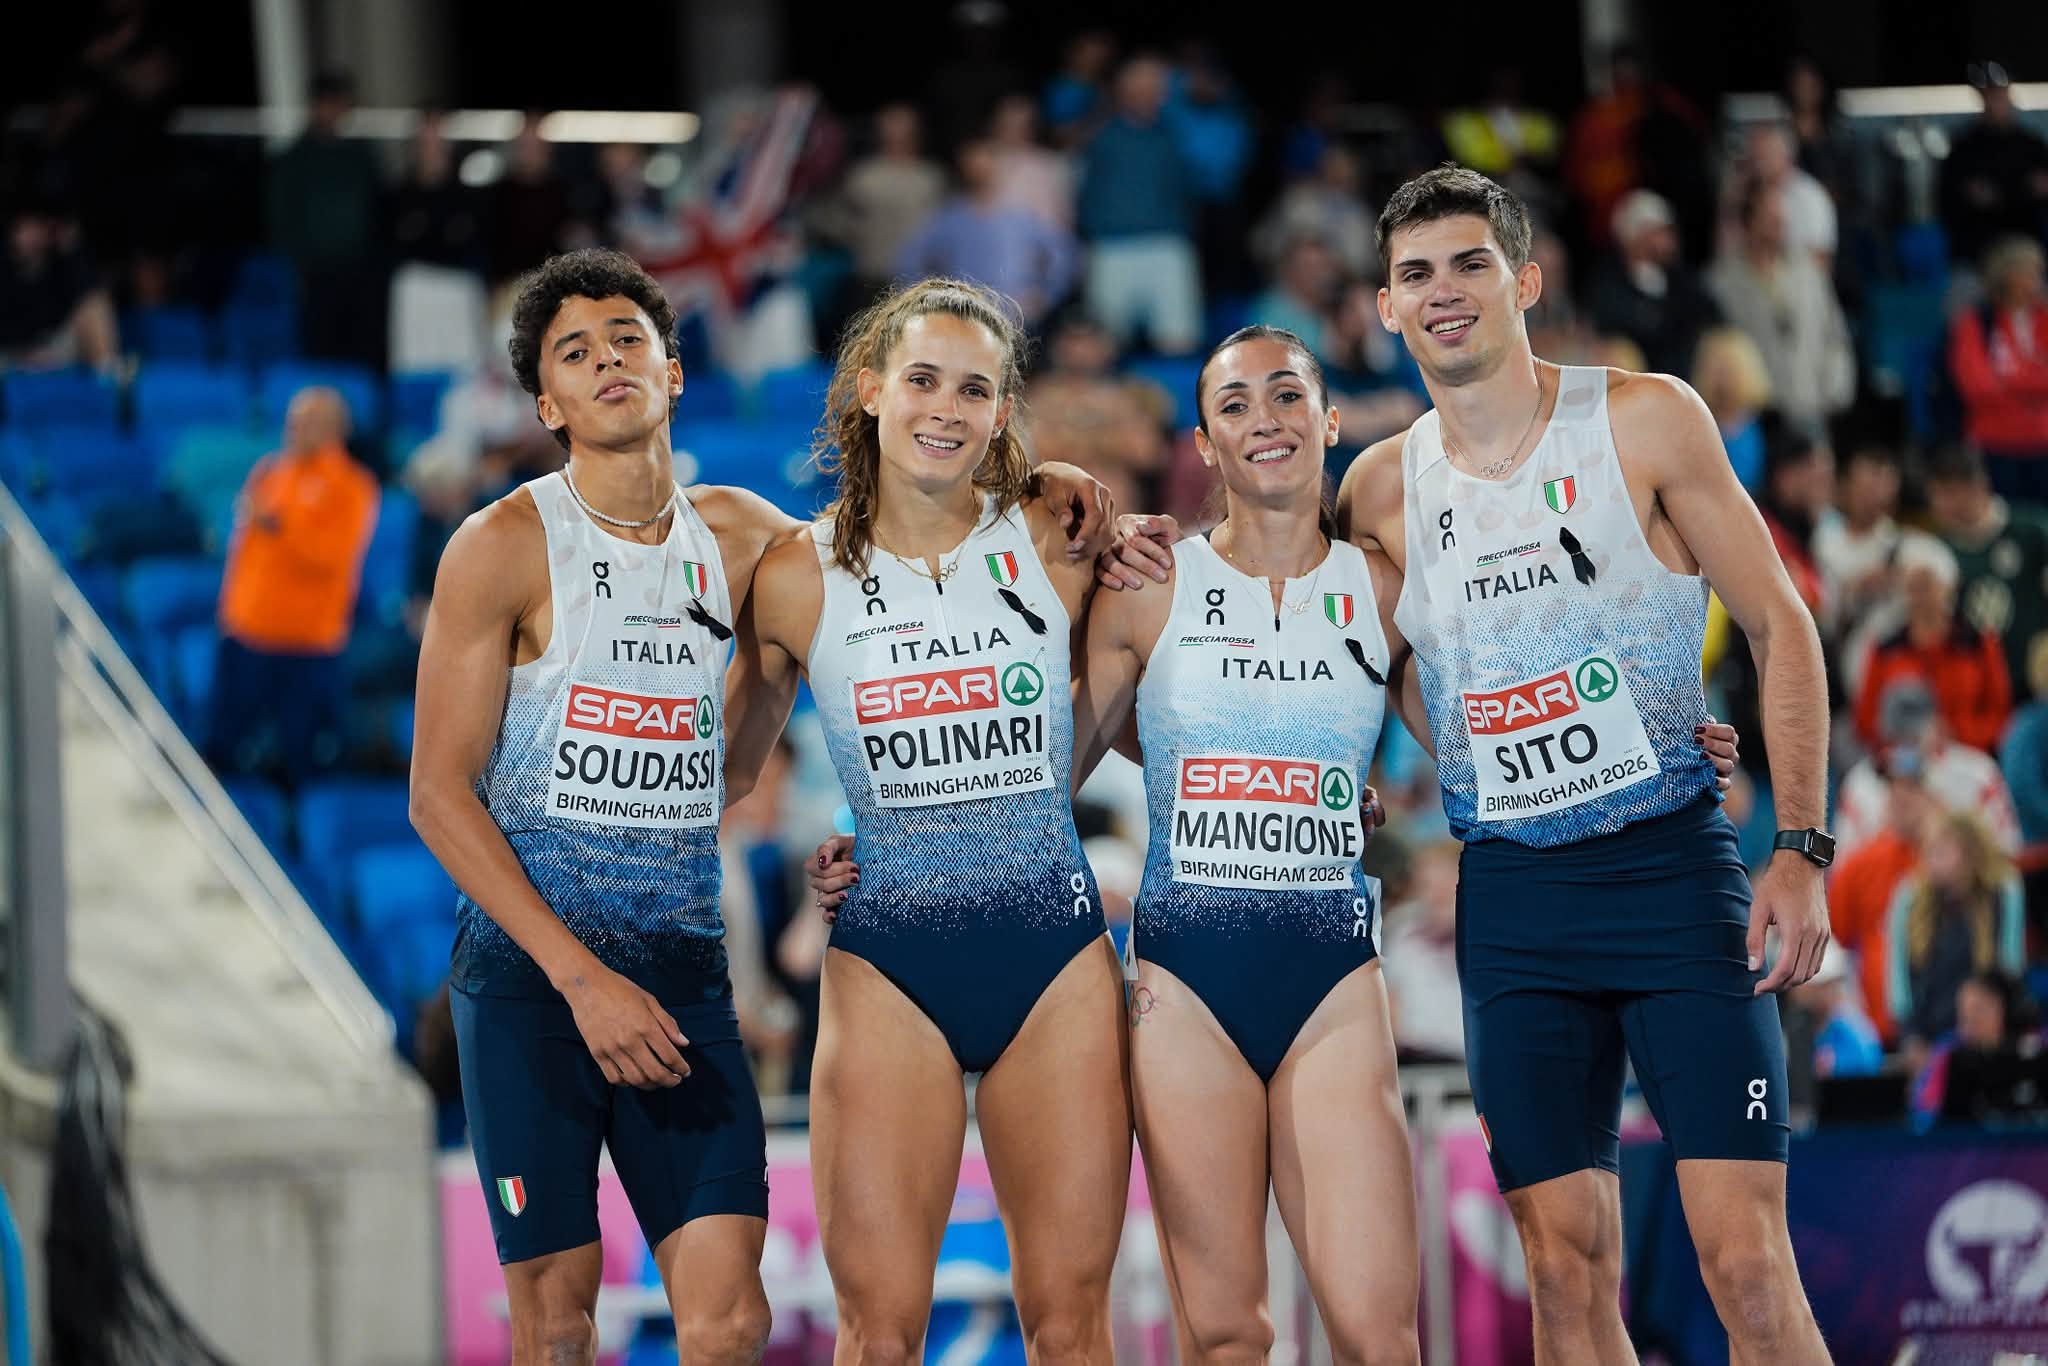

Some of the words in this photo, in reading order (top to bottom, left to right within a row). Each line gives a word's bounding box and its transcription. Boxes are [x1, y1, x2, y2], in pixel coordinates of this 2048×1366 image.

[1477, 541, 1541, 564] FRECCIAROSSA
[1464, 564, 1558, 602] ITALIA
[846, 621, 924, 641] FRECCIAROSSA
[891, 627, 1011, 663] ITALIA
[1179, 635, 1256, 645] FRECCIAROSSA
[612, 639, 695, 665] ITALIA
[1222, 657, 1334, 681] ITALIA
[571, 692, 694, 735] SPAR
[859, 673, 995, 718] SPAR
[1467, 680, 1573, 729] SPAR
[864, 714, 1043, 771] POLINARI
[1495, 723, 1598, 783] SITO
[555, 740, 715, 792] SOUDASSI
[880, 773, 999, 799] BIRMINGHAM
[1003, 766, 1044, 786] 2026
[1186, 764, 1315, 799] SPAR
[1486, 776, 1599, 813] BIRMINGHAM
[1600, 754, 1648, 785] 2026
[556, 792, 682, 819] BIRMINGHAM
[684, 801, 713, 819] 2026
[1175, 810, 1357, 858] MANGIONE
[1181, 861, 1305, 882] BIRMINGHAM
[1309, 866, 1346, 882] 2026
